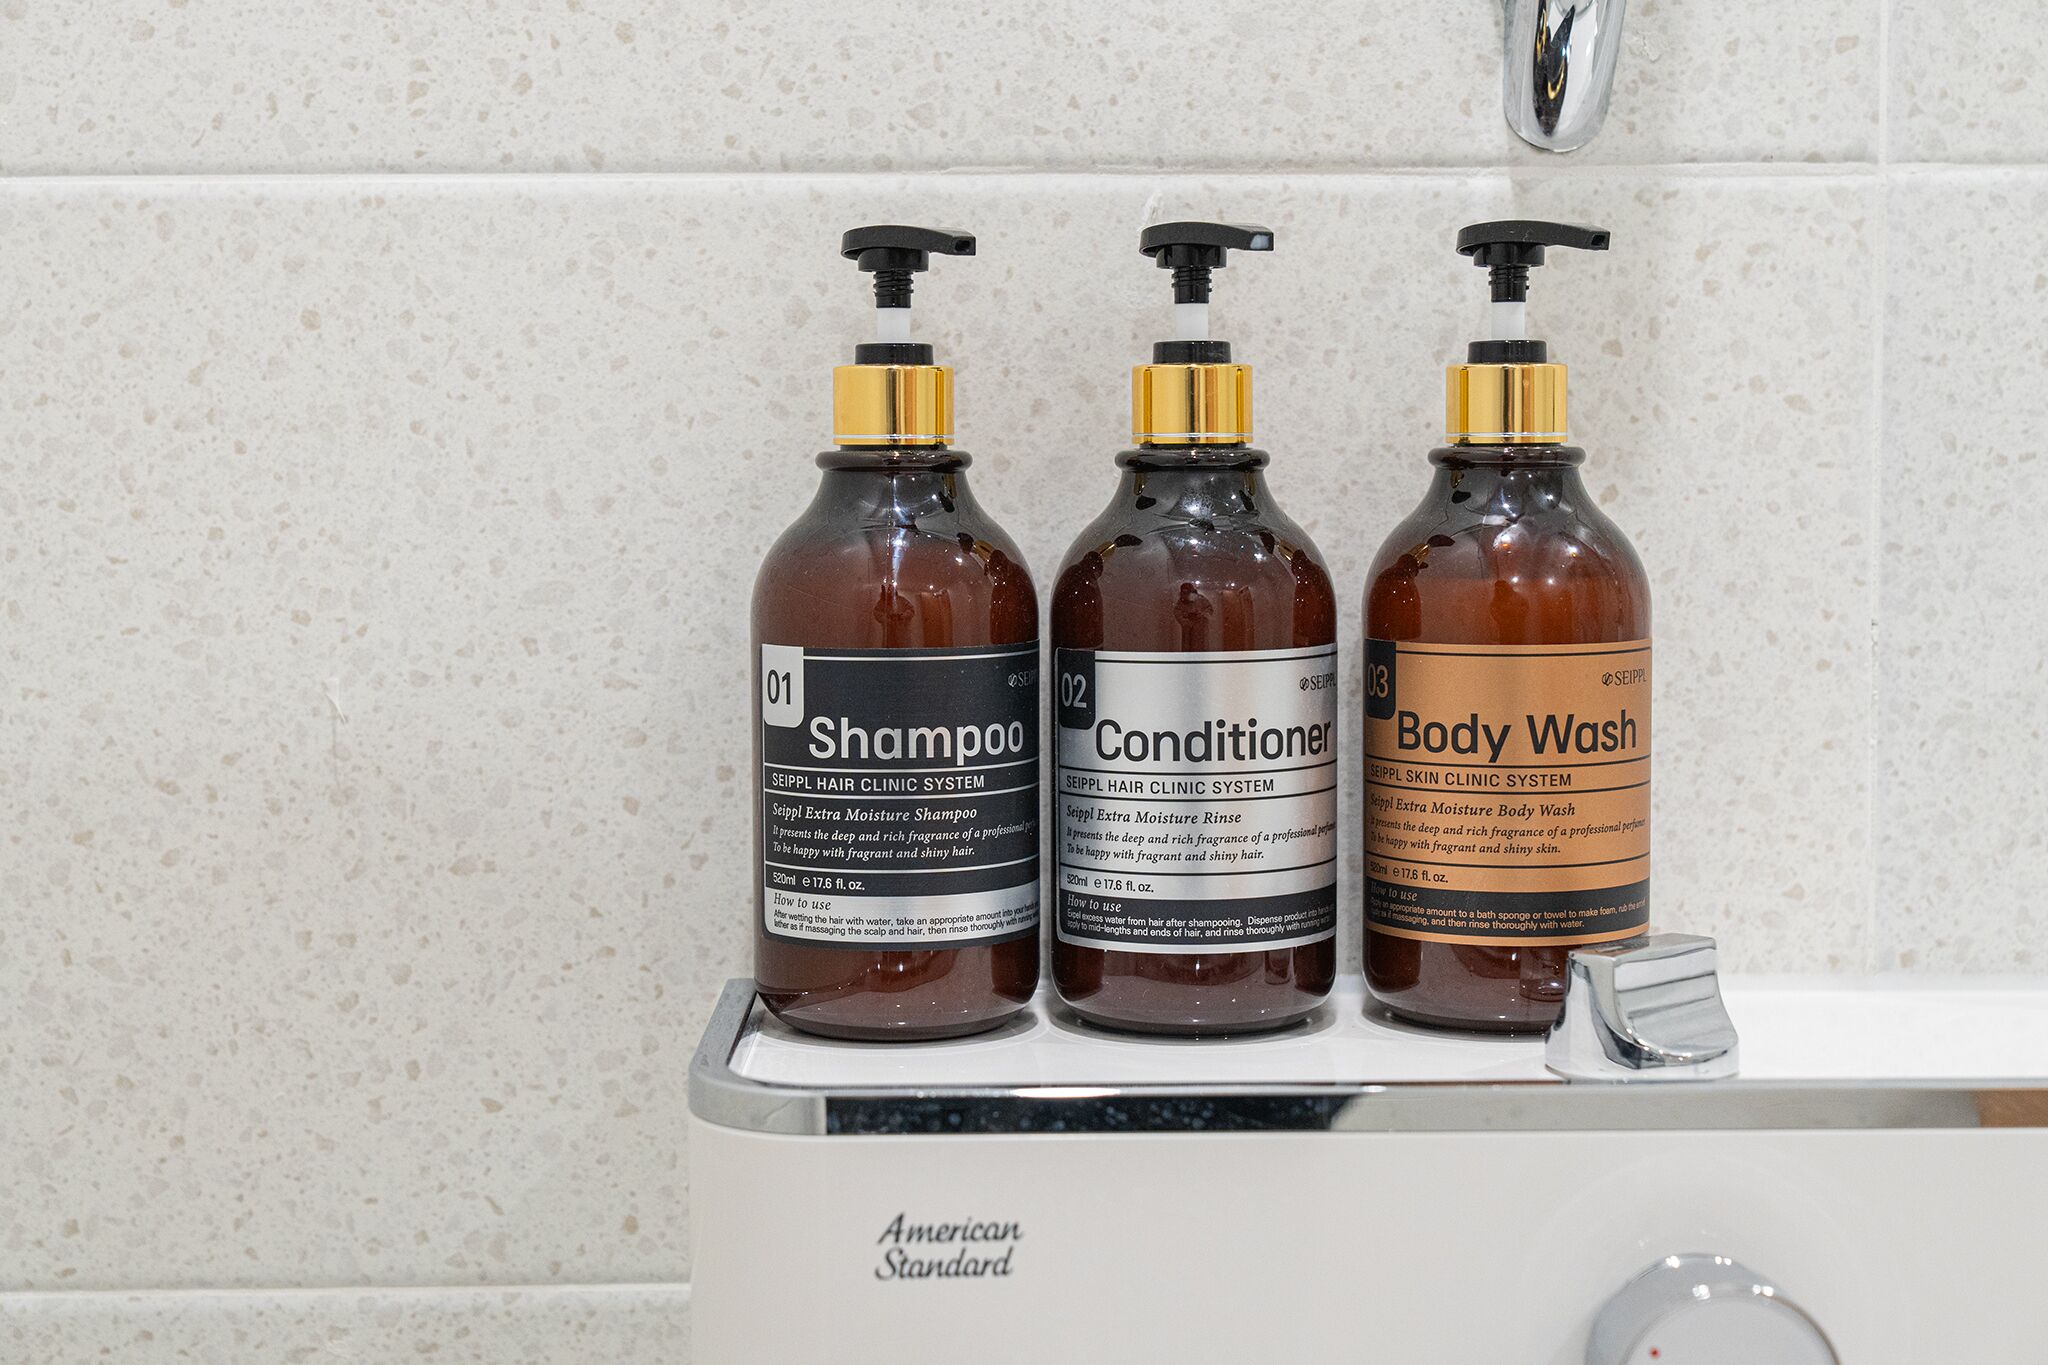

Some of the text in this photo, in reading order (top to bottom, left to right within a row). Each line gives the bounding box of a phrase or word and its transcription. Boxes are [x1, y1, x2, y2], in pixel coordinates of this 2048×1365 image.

[767, 669, 791, 705] 01
[1367, 663, 1388, 698] 03
[1614, 668, 1647, 686] SEIPPL
[1061, 672, 1087, 708] 02
[809, 716, 1024, 766] Shampoo
[1096, 718, 1331, 762] Conditioner
[1398, 709, 1636, 763] Body Wash
[772, 773, 985, 792] SEIPPL HAIR CLINIC SYSTEM
[1066, 775, 1274, 795] SEIPPL HAIR CLINIC SYSTEM
[1370, 765, 1571, 787] SEIPPL SKIN CLINIC SYSTEM
[773, 803, 977, 823] Seippl Extra Moisture Shampoo
[1067, 805, 1241, 824] Seippl Extra Moisture Rinse
[1396, 798, 1427, 813] Extra
[1431, 802, 1492, 816] Moisture
[1497, 804, 1534, 820] Body
[1540, 803, 1575, 816] Wash
[780, 827, 811, 839] presents
[814, 830, 829, 840] the
[832, 830, 855, 844] deep
[859, 831, 880, 841] and
[883, 830, 904, 841] rich
[907, 831, 959, 844] fragrance
[962, 828, 973, 841] of
[982, 820, 1025, 840] professional
[1073, 825, 1317, 847] presents the deep and rich fragrance of professional
[1376, 818, 1621, 840] presents the deep and rich fragrance of professional
[783, 843, 975, 861] be happy with fragrant and shiny hair.
[1076, 845, 1264, 863] be happy with fragrant and shiny hair.
[1386, 835, 1560, 856] happy with fragrant and shiny skin.
[773, 872, 796, 886] 520ml
[836, 879, 846, 889] fl.
[848, 881, 865, 890] oz.
[1067, 874, 1087, 887] 520ml
[1126, 881, 1135, 891] fl.
[1138, 883, 1154, 892] oz.
[1422, 870, 1431, 881] fl.
[1433, 874, 1448, 883] oz.
[774, 893, 831, 910] How to use
[1068, 894, 1121, 912] How to use
[1389, 887, 1417, 901] to use
[788, 914, 812, 924] wetting
[815, 915, 827, 923] the
[829, 916, 842, 924] hair
[846, 917, 865, 925] with
[866, 918, 893, 926] water,
[897, 917, 914, 925] take
[930, 915, 974, 926] appropriate
[976, 911, 1002, 920] amount
[1014, 906, 1024, 915] your
[1105, 916, 1125, 924] water
[1128, 916, 1146, 925] from
[1149, 918, 1163, 926] hair
[1166, 918, 1186, 927] after
[1189, 918, 1242, 928] shampooing.
[1248, 914, 1282, 925] Dispense
[1284, 911, 1307, 922] product
[1392, 912, 1584, 931] massaging, and then rinse thoroughly with water.
[1427, 909, 1457, 917] amount
[1477, 910, 1496, 919] bath
[1498, 911, 1530, 921] sponge
[1544, 910, 1566, 919] towel
[1569, 910, 1577, 918] to
[1579, 907, 1598, 917] make
[1600, 906, 1617, 915] foam,
[805, 925, 845, 936] massaging
[848, 926, 861, 935] the
[864, 927, 886, 936] scalp
[889, 926, 904, 936] and
[907, 927, 925, 936] hair,
[928, 926, 947, 934] then
[971, 921, 1005, 931] thoroughly
[1006, 918, 1017, 926] with
[1089, 921, 1300, 938] mid-lengths and ends of hair, and rinse thoroughly with
[877, 1212, 1024, 1245] American
[875, 1246, 1014, 1281] Standard
